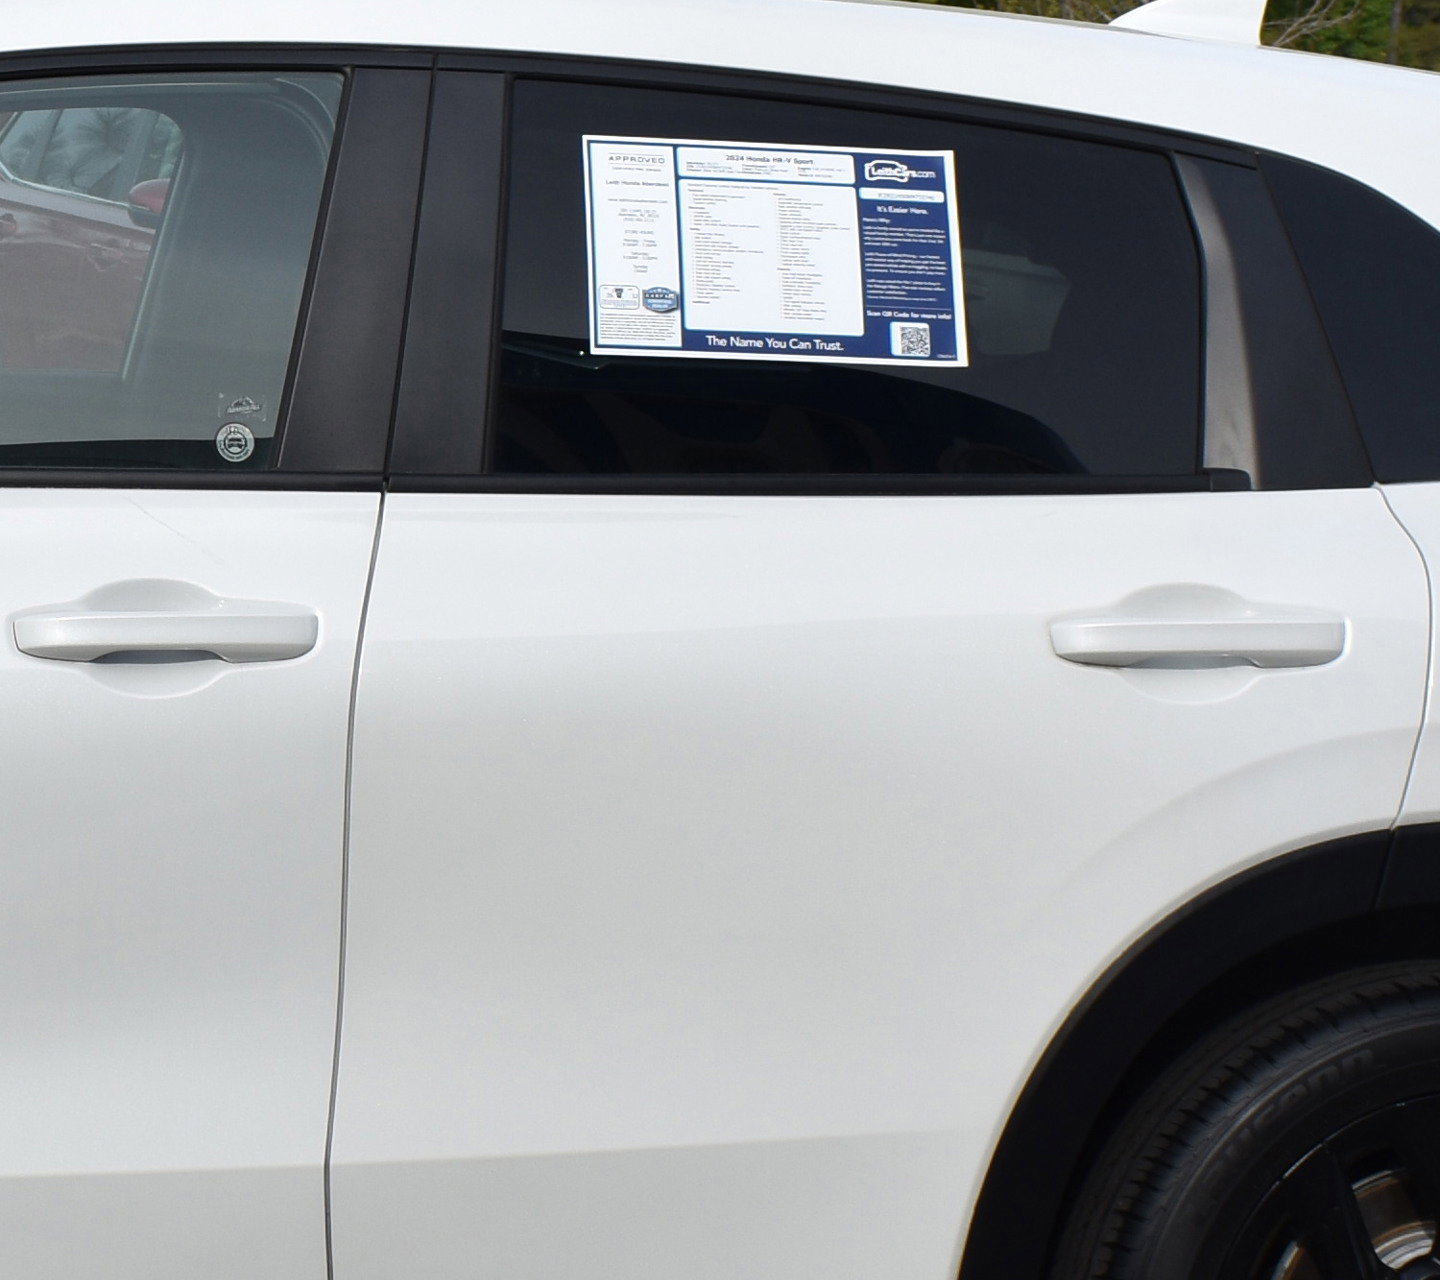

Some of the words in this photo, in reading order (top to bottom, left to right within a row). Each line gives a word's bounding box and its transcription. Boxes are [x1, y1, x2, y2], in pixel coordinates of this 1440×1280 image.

[608, 156, 665, 164] APPROVED
[746, 155, 770, 163] Honda
[705, 335, 727, 346] The
[730, 336, 763, 348] Name
[765, 337, 787, 349] You
[789, 338, 811, 349] Can
[813, 339, 844, 351] Trust.
